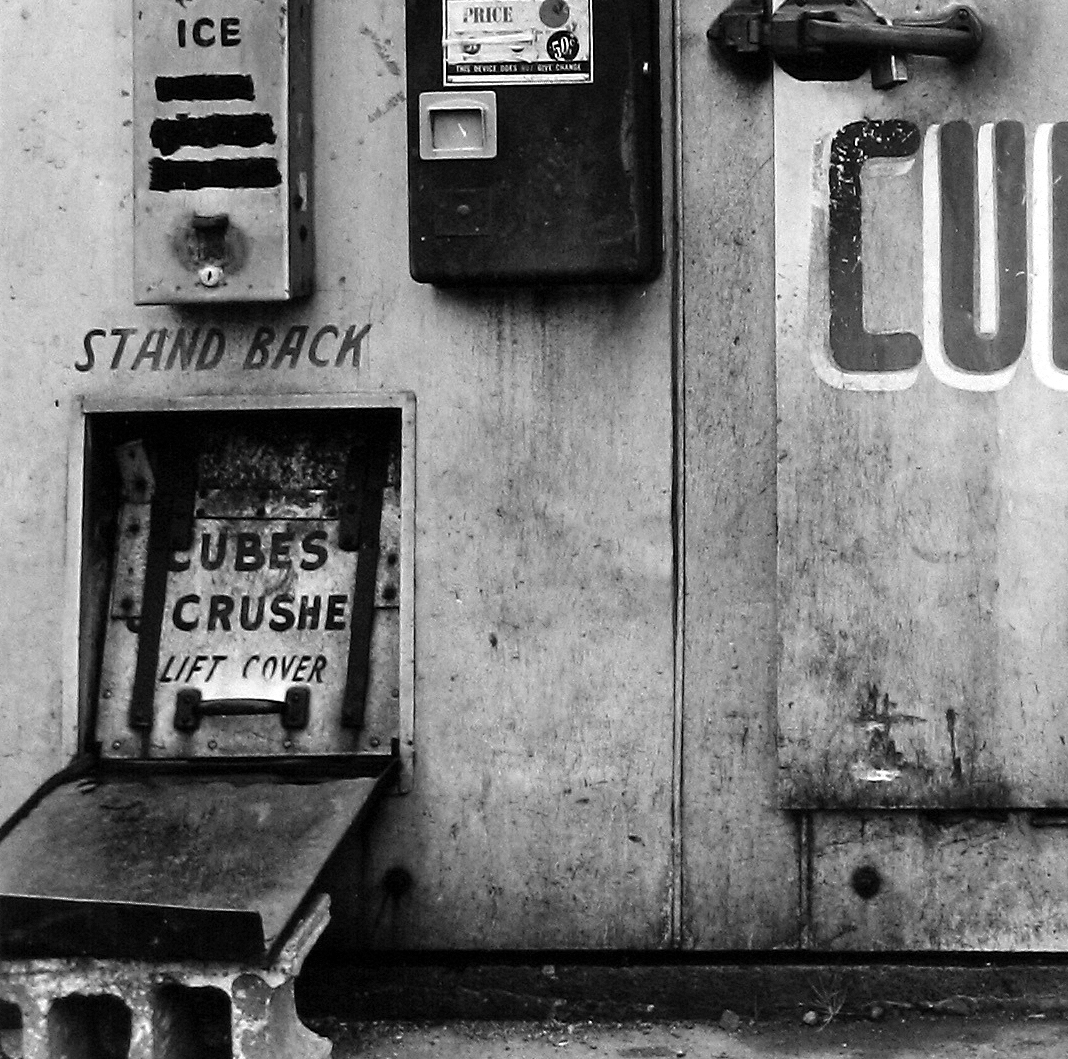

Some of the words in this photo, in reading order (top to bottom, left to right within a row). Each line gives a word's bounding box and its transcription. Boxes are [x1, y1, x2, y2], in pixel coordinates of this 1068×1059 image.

[463, 7, 513, 23] PRICE
[177, 17, 242, 48] ICE
[75, 326, 227, 372] STAND
[243, 324, 372, 370] BACK
[159, 655, 227, 683] LIFT
[243, 654, 327, 683] COVER
